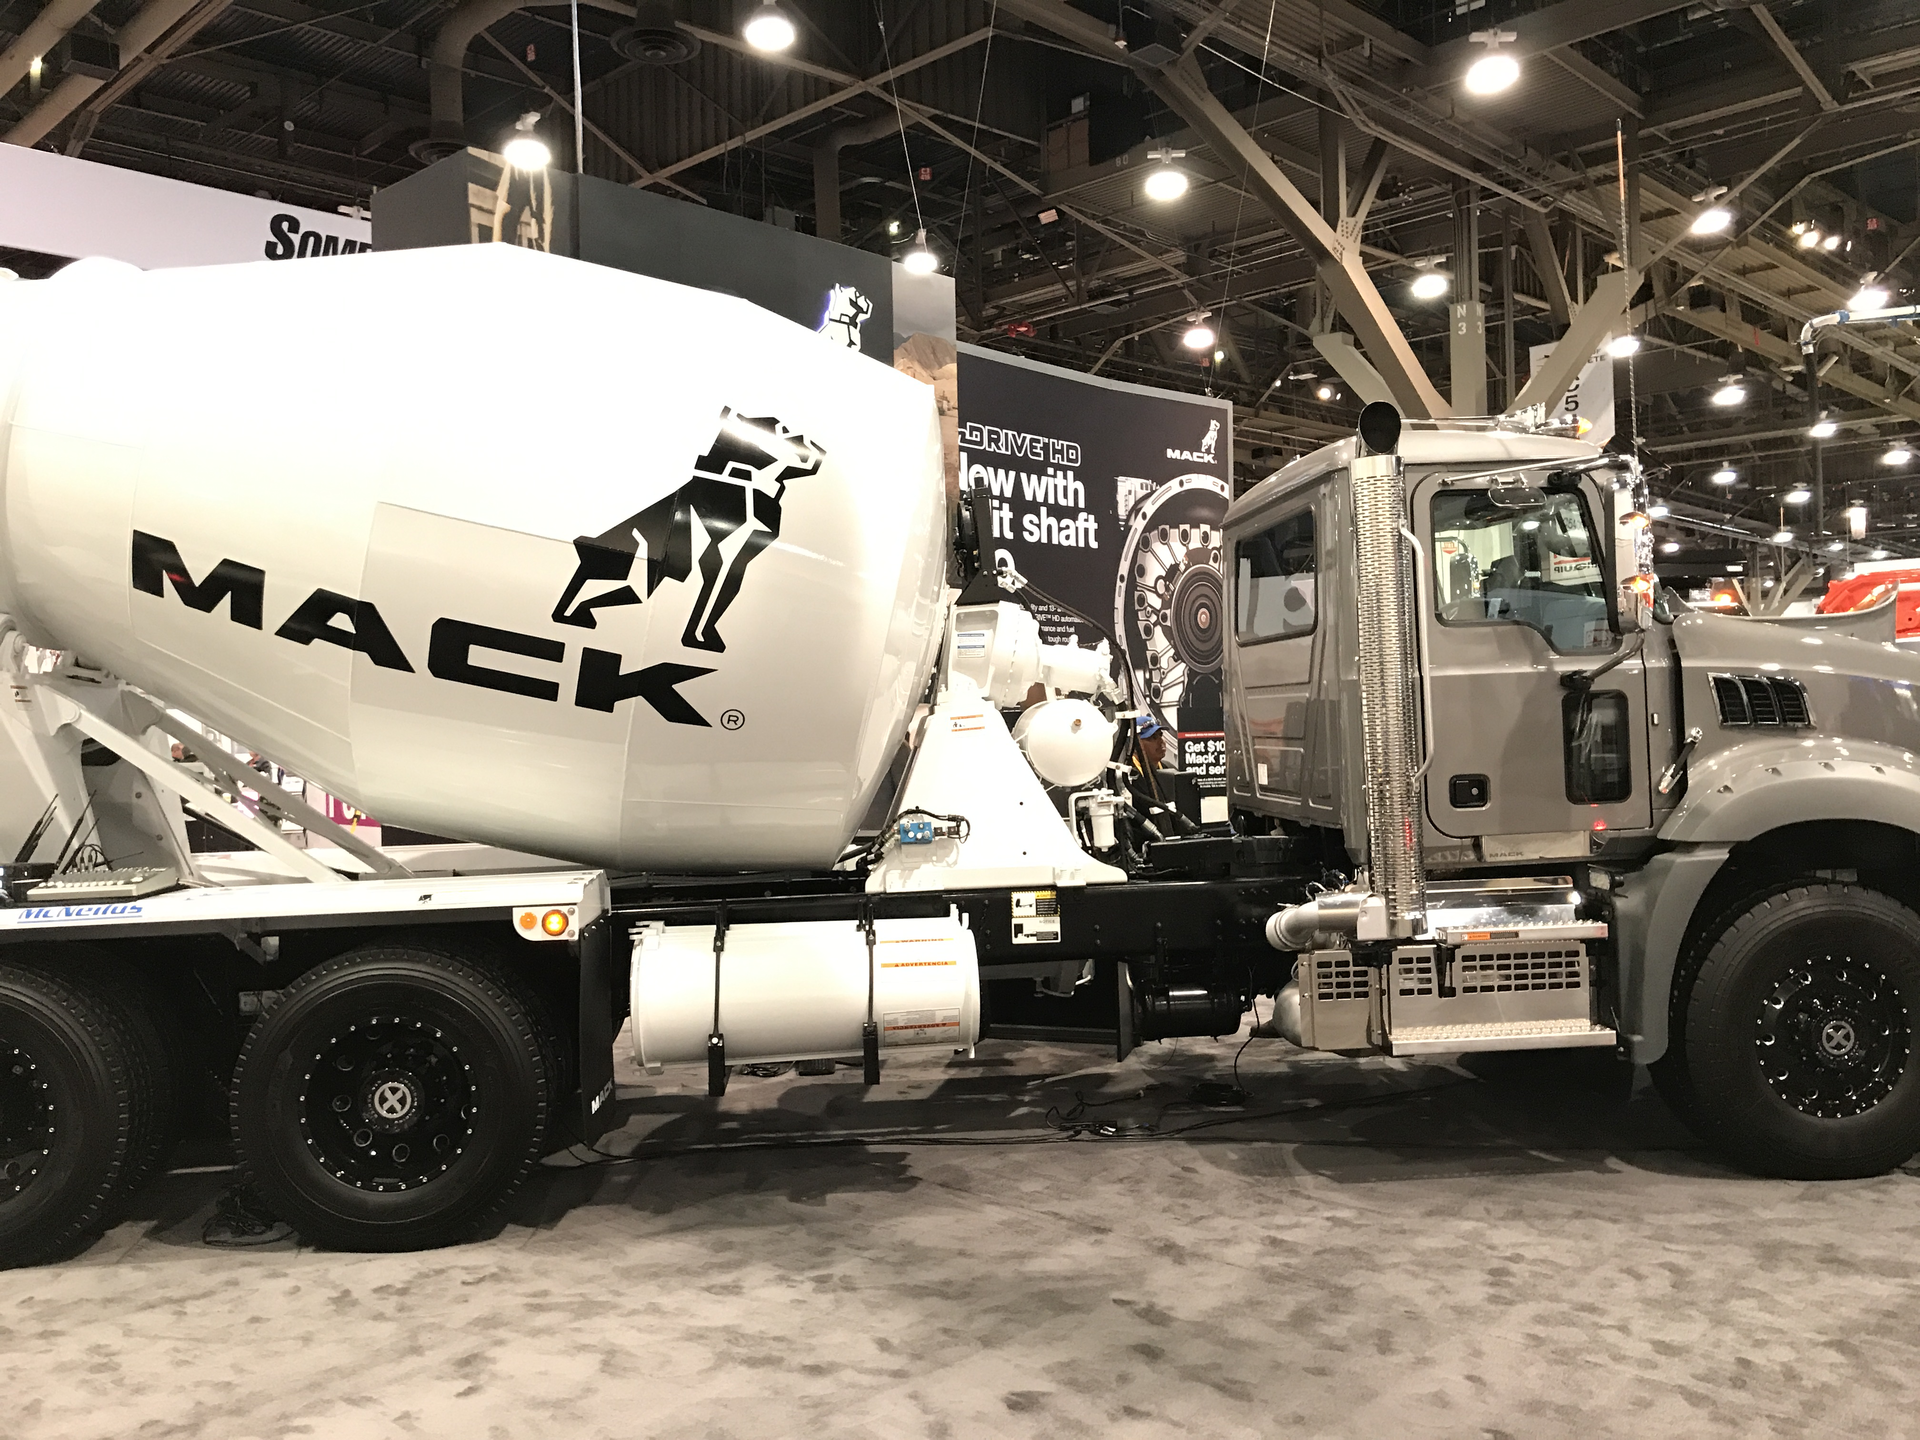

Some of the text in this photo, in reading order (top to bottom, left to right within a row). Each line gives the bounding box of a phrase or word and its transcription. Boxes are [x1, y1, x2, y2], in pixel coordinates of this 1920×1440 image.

[1456, 304, 1467, 319] N
[1457, 321, 1467, 335] 3
[1564, 394, 1580, 412] 5
[1049, 438, 1082, 467] HD
[1019, 467, 1086, 509] with
[1022, 506, 1099, 549] shaft
[131, 529, 719, 728] MACK
[1184, 740, 1205, 752] Get
[1488, 851, 1524, 859] MACK
